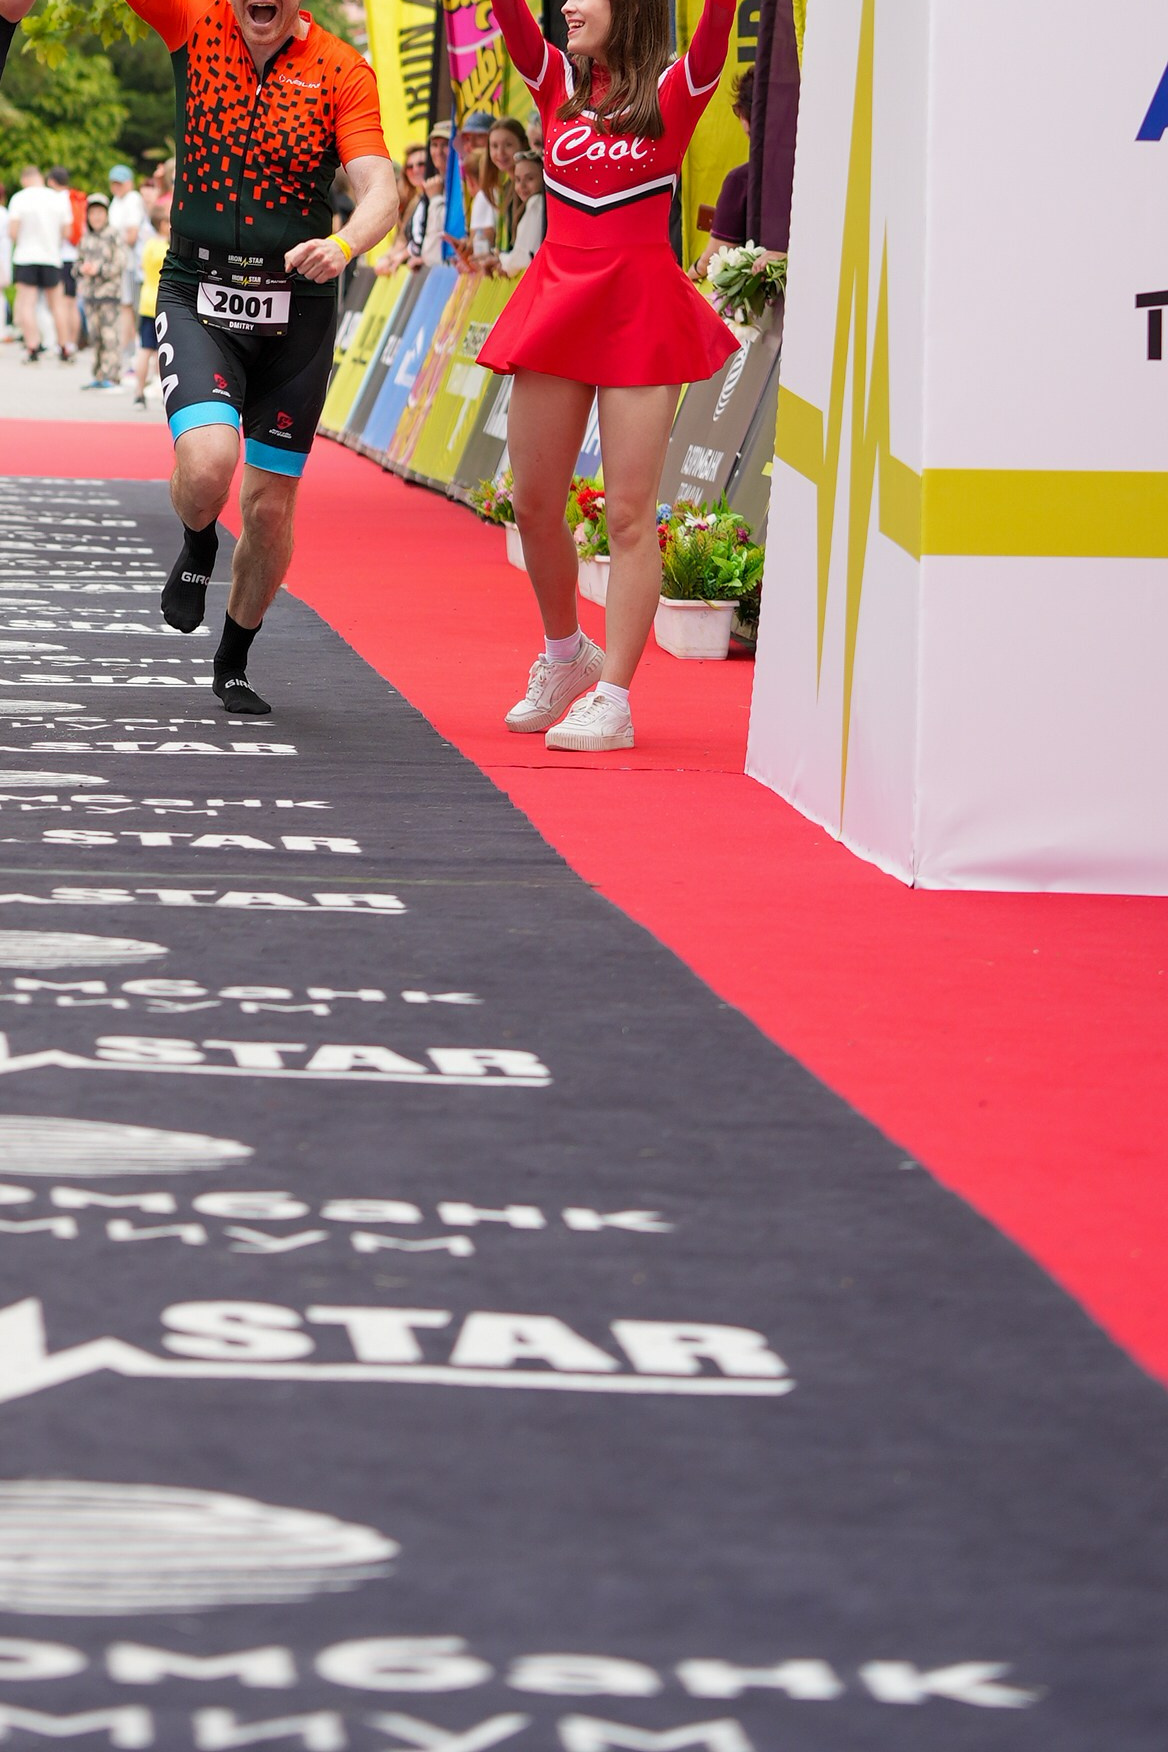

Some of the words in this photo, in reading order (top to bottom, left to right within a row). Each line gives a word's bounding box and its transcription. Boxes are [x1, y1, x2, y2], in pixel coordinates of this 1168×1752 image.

[551, 125, 648, 166] Cool
[213, 291, 273, 319] 2001
[229, 321, 255, 331] DMITRY
[30, 741, 299, 754] STAR
[40, 829, 363, 854] STAR
[50, 887, 407, 909] STAR
[94, 1035, 551, 1078] STAR
[157, 1300, 788, 1378] STAR
